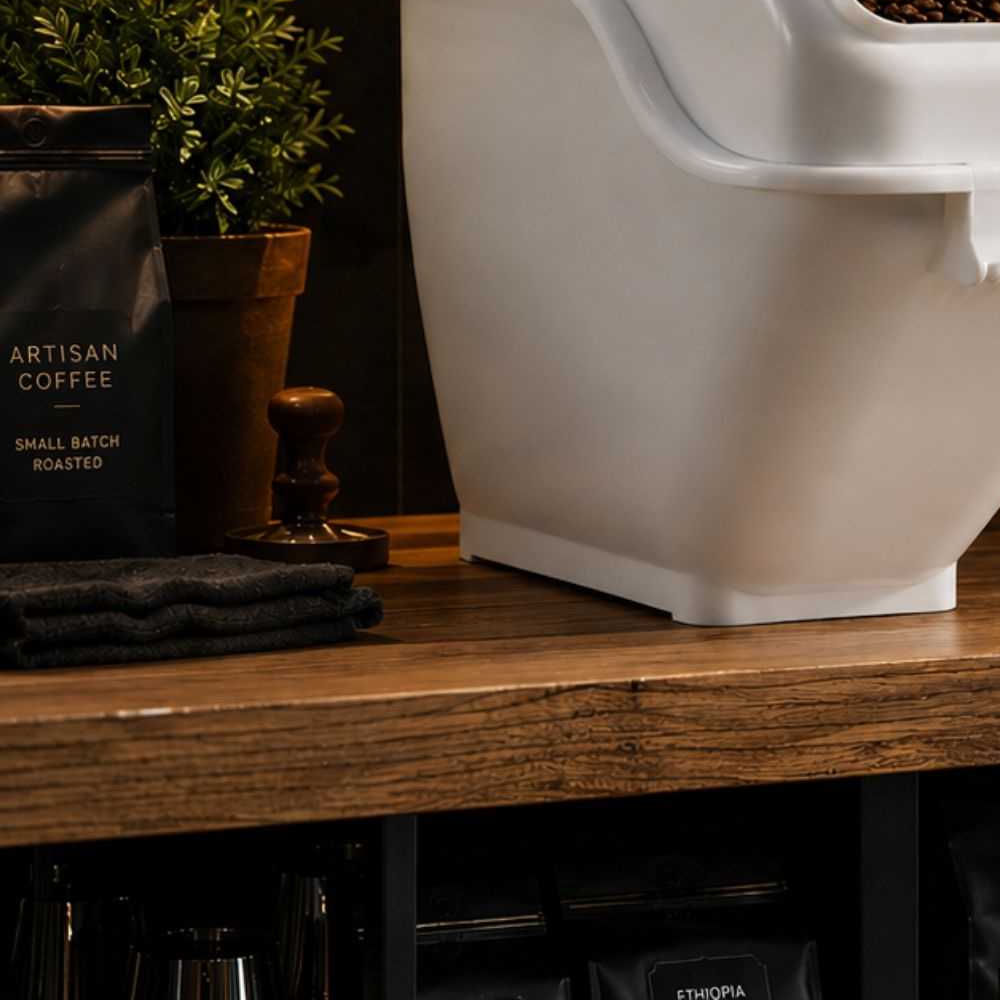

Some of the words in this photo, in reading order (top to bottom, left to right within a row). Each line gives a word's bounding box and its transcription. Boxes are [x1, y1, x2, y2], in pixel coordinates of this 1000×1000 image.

[9, 343, 119, 365] ARTISAN
[18, 370, 113, 391] COFFEE
[15, 437, 66, 452] SMALL
[70, 434, 121, 450] BATCH
[32, 456, 104, 472] ROASTED
[676, 984, 746, 1000] ETHIOPIA
